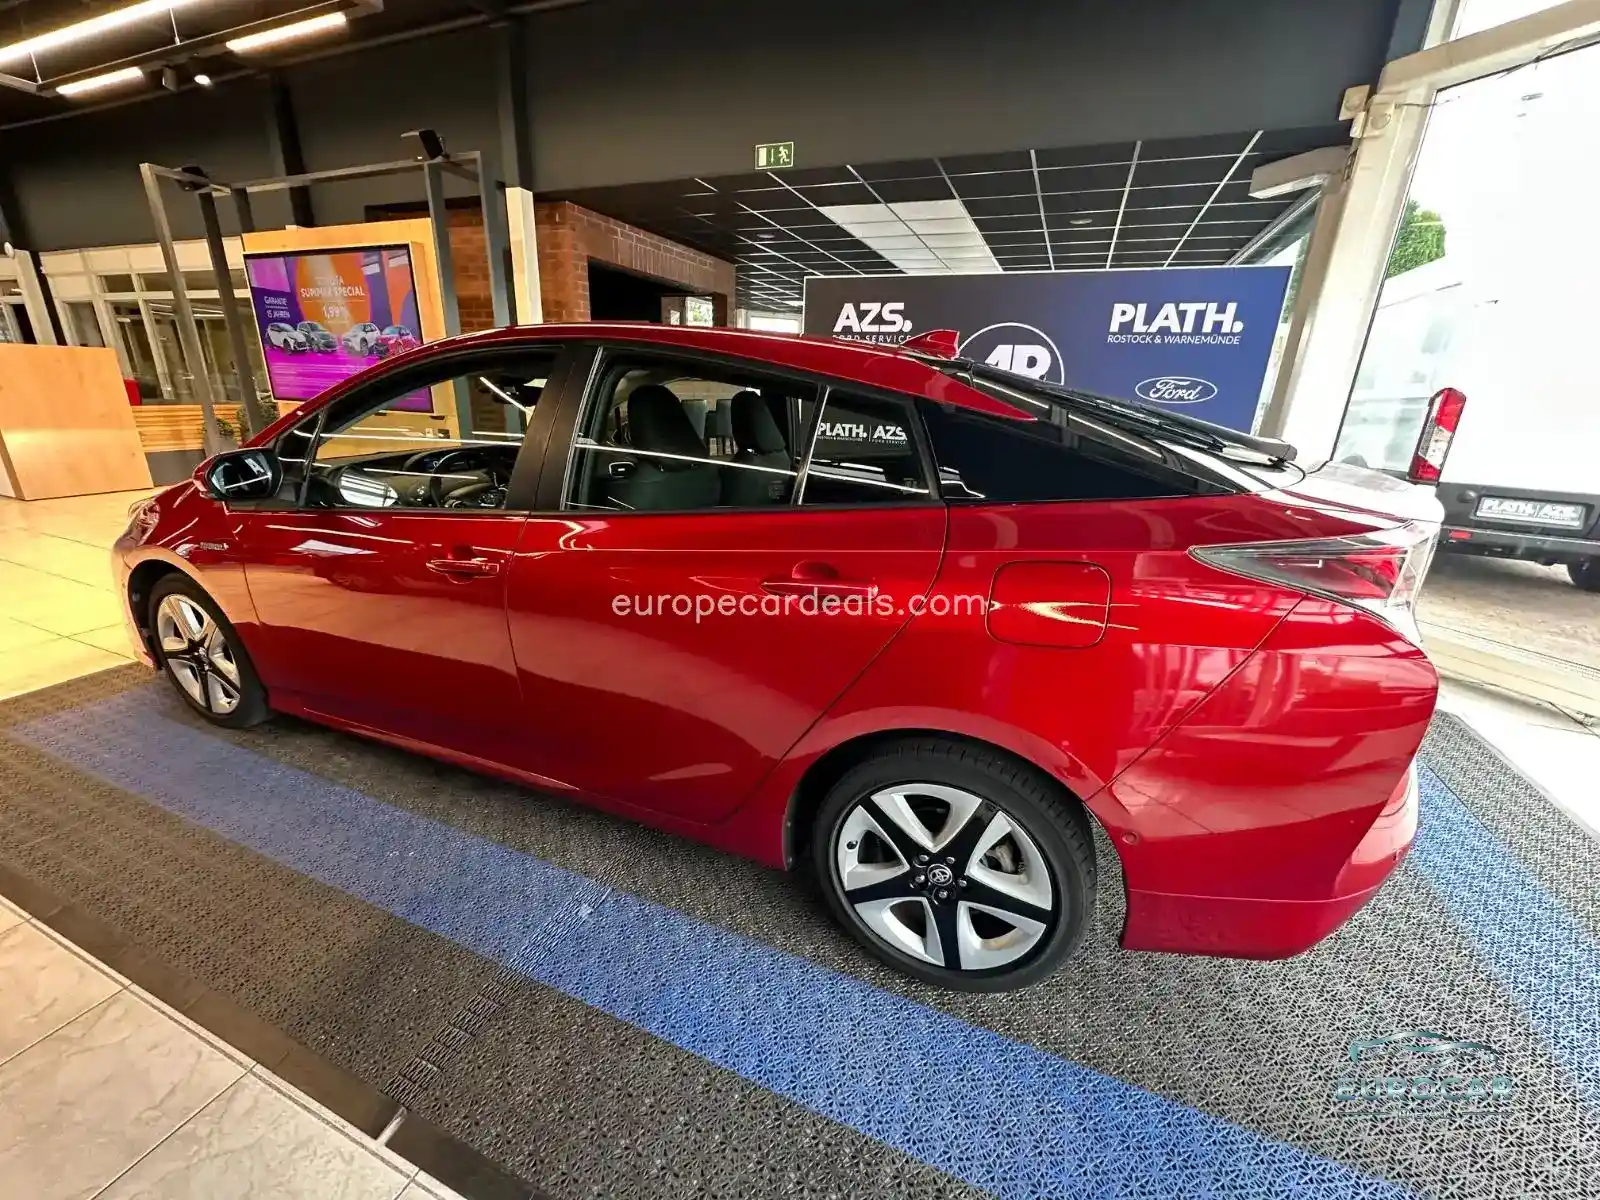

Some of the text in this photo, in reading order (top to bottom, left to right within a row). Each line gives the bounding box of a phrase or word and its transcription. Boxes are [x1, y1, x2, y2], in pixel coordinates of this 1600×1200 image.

[832, 302, 913, 333] AZS.
[1108, 302, 1244, 333] PLATH.
[1107, 334, 1241, 345] ROSTOCK & WARNEMÜNDE
[1149, 379, 1204, 400] Ford
[817, 422, 868, 438] PLATH.
